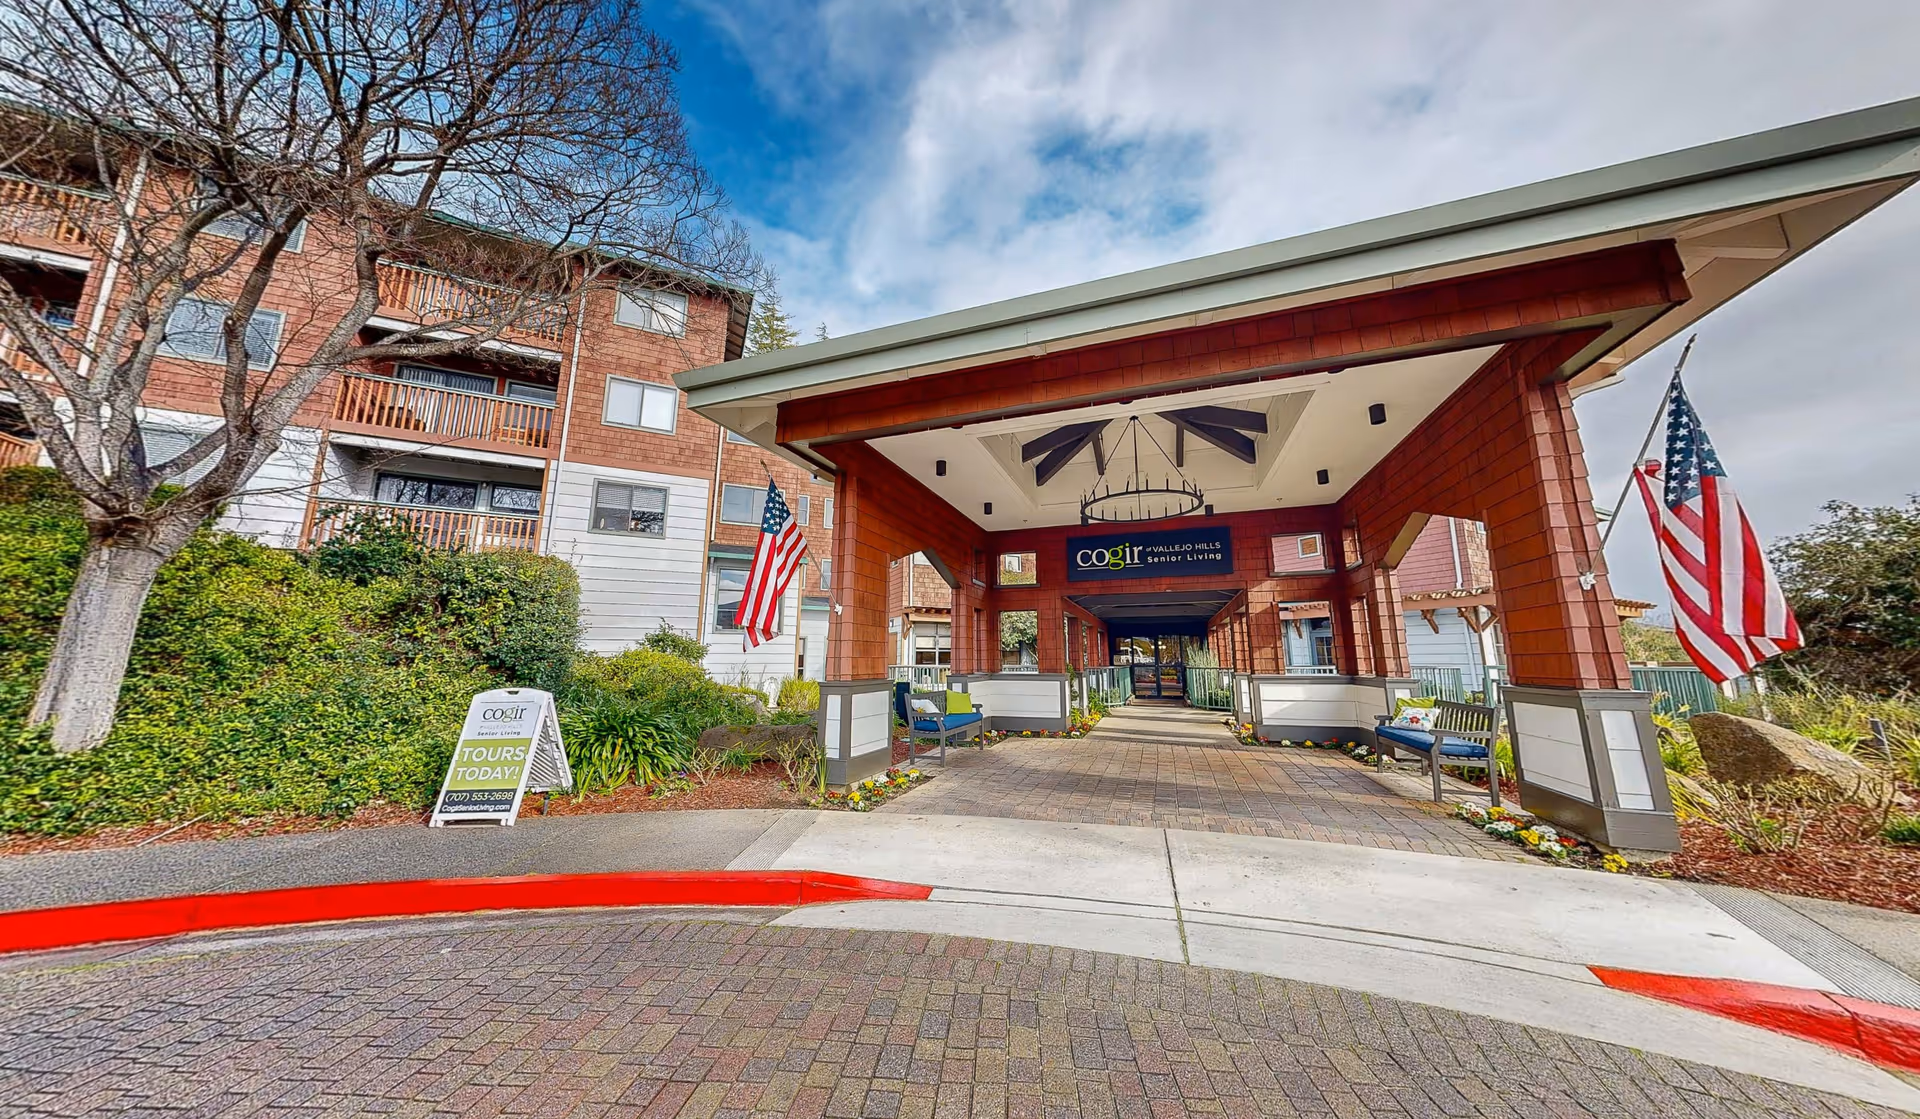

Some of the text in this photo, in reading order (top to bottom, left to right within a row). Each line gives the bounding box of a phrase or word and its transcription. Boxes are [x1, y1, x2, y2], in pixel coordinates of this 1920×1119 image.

[1152, 544, 1193, 553] VALLEJO
[1195, 541, 1221, 550] HILLS
[1076, 542, 1143, 570] cogir
[1147, 552, 1222, 563] Senior Living
[482, 705, 527, 723] cogir
[462, 746, 525, 762] TOURS
[456, 766, 520, 780] TODAY!
[445, 791, 514, 802] (707) 553-2698
